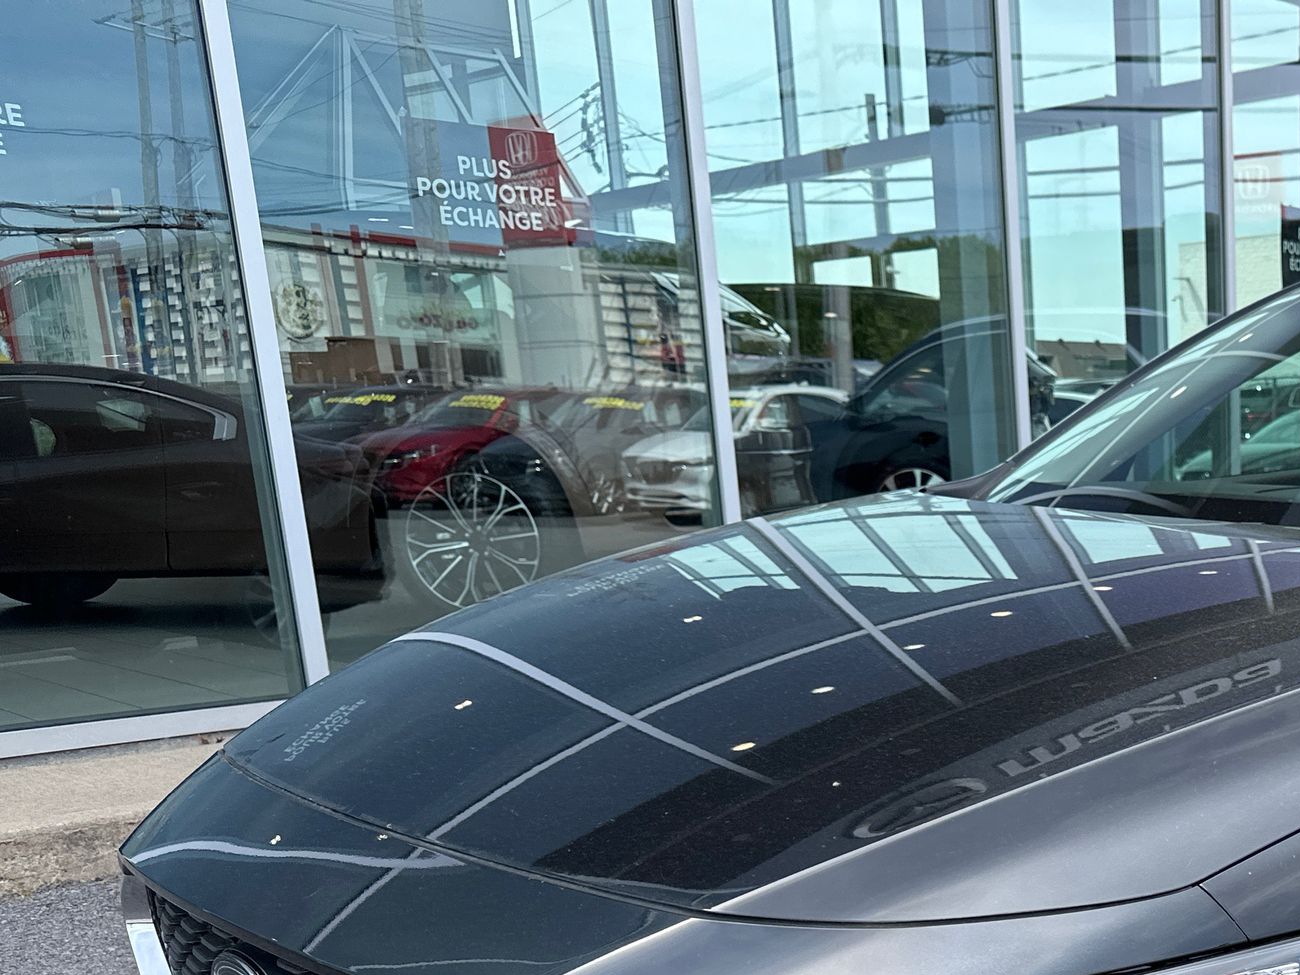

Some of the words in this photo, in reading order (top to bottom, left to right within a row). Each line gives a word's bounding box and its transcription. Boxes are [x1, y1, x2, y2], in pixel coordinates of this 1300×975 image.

[457, 156, 512, 179] PLUS
[416, 177, 481, 202] POUR
[484, 183, 557, 207] VOTRE
[440, 201, 544, 231] ÉCHANGE
